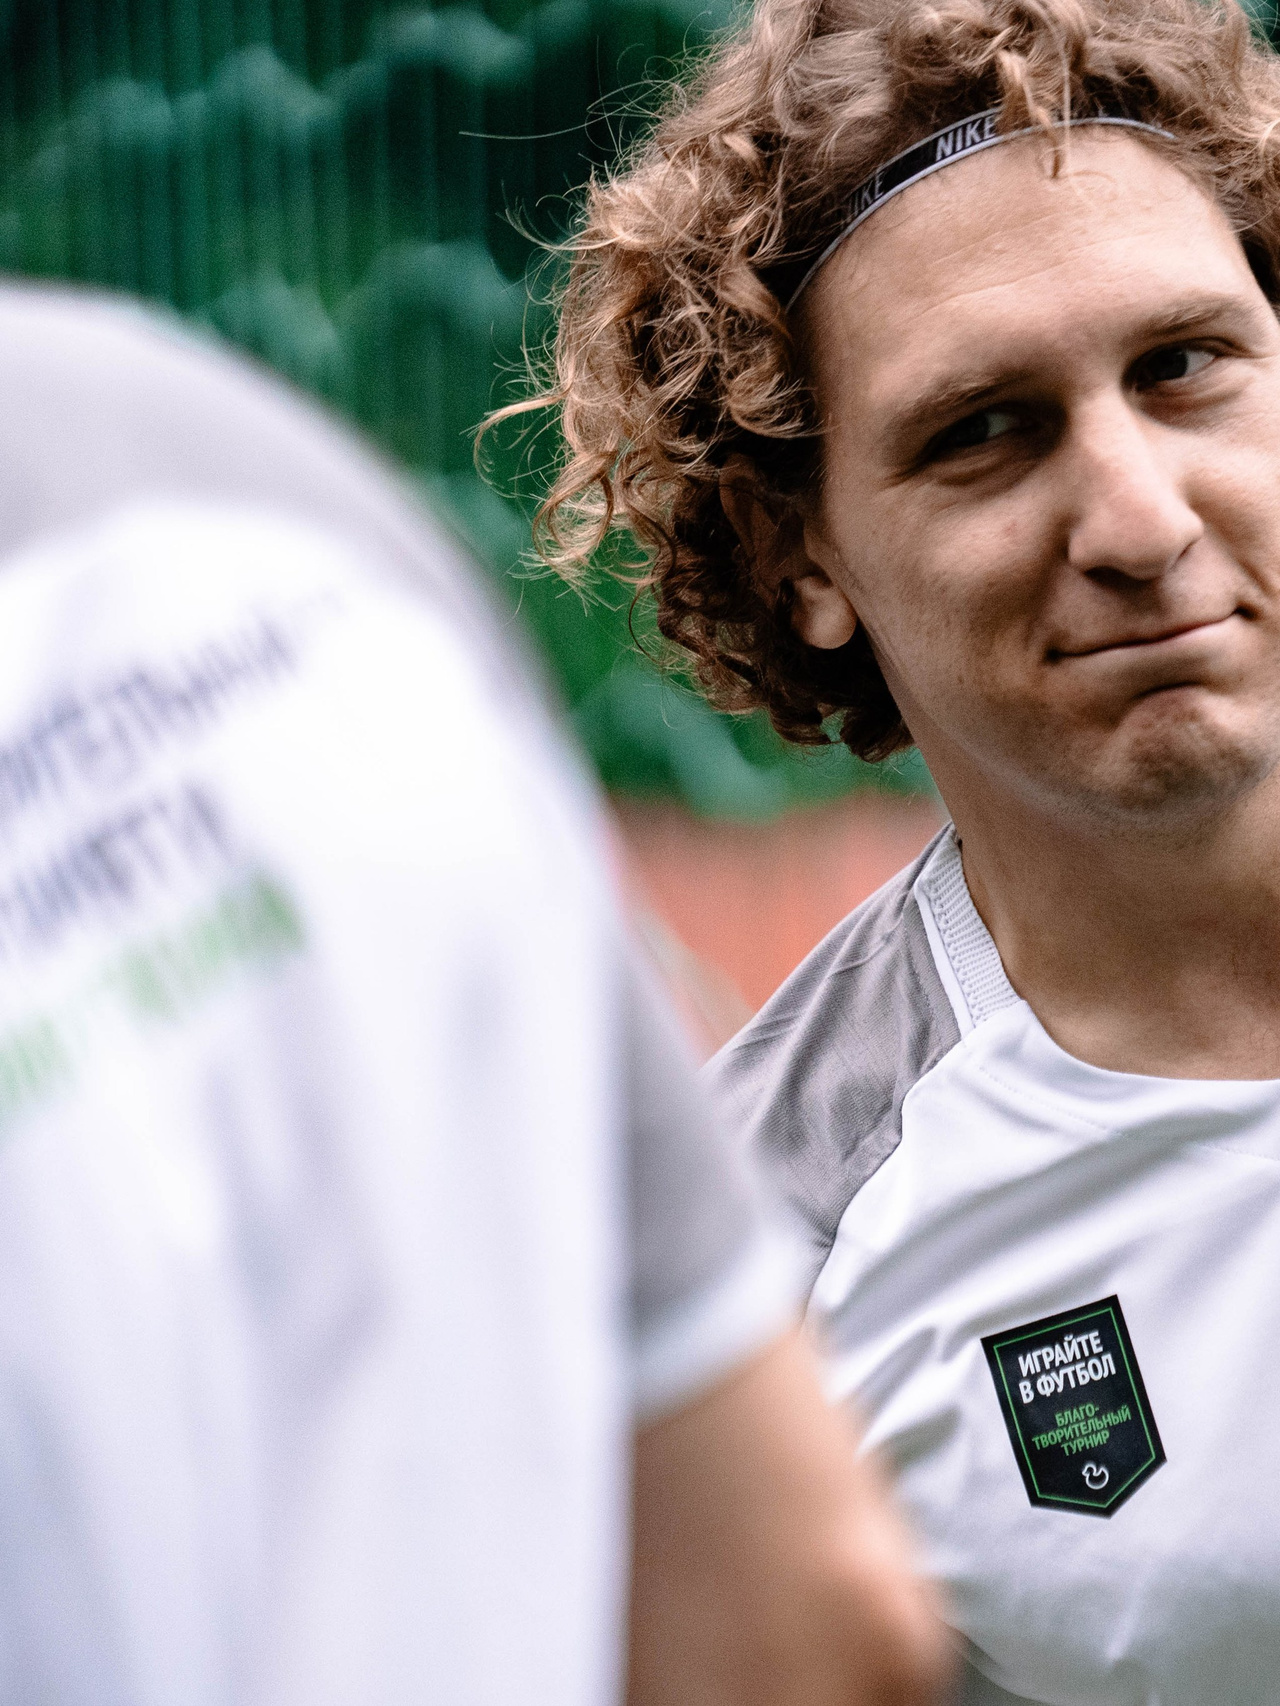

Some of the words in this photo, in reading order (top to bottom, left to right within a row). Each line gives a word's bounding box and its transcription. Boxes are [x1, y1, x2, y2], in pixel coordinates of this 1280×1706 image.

[935, 116, 997, 162] NIKE
[1018, 1330, 1103, 1377] ИГРАЙТЕ
[1019, 1380, 1034, 1404] В
[1036, 1354, 1117, 1397] ФУТБОЛ
[1032, 1405, 1132, 1450] ТВОРИТЕЛЬНЫЙ
[1055, 1404, 1100, 1427] БЛАГО-
[1061, 1430, 1110, 1456] ТУРНИР
